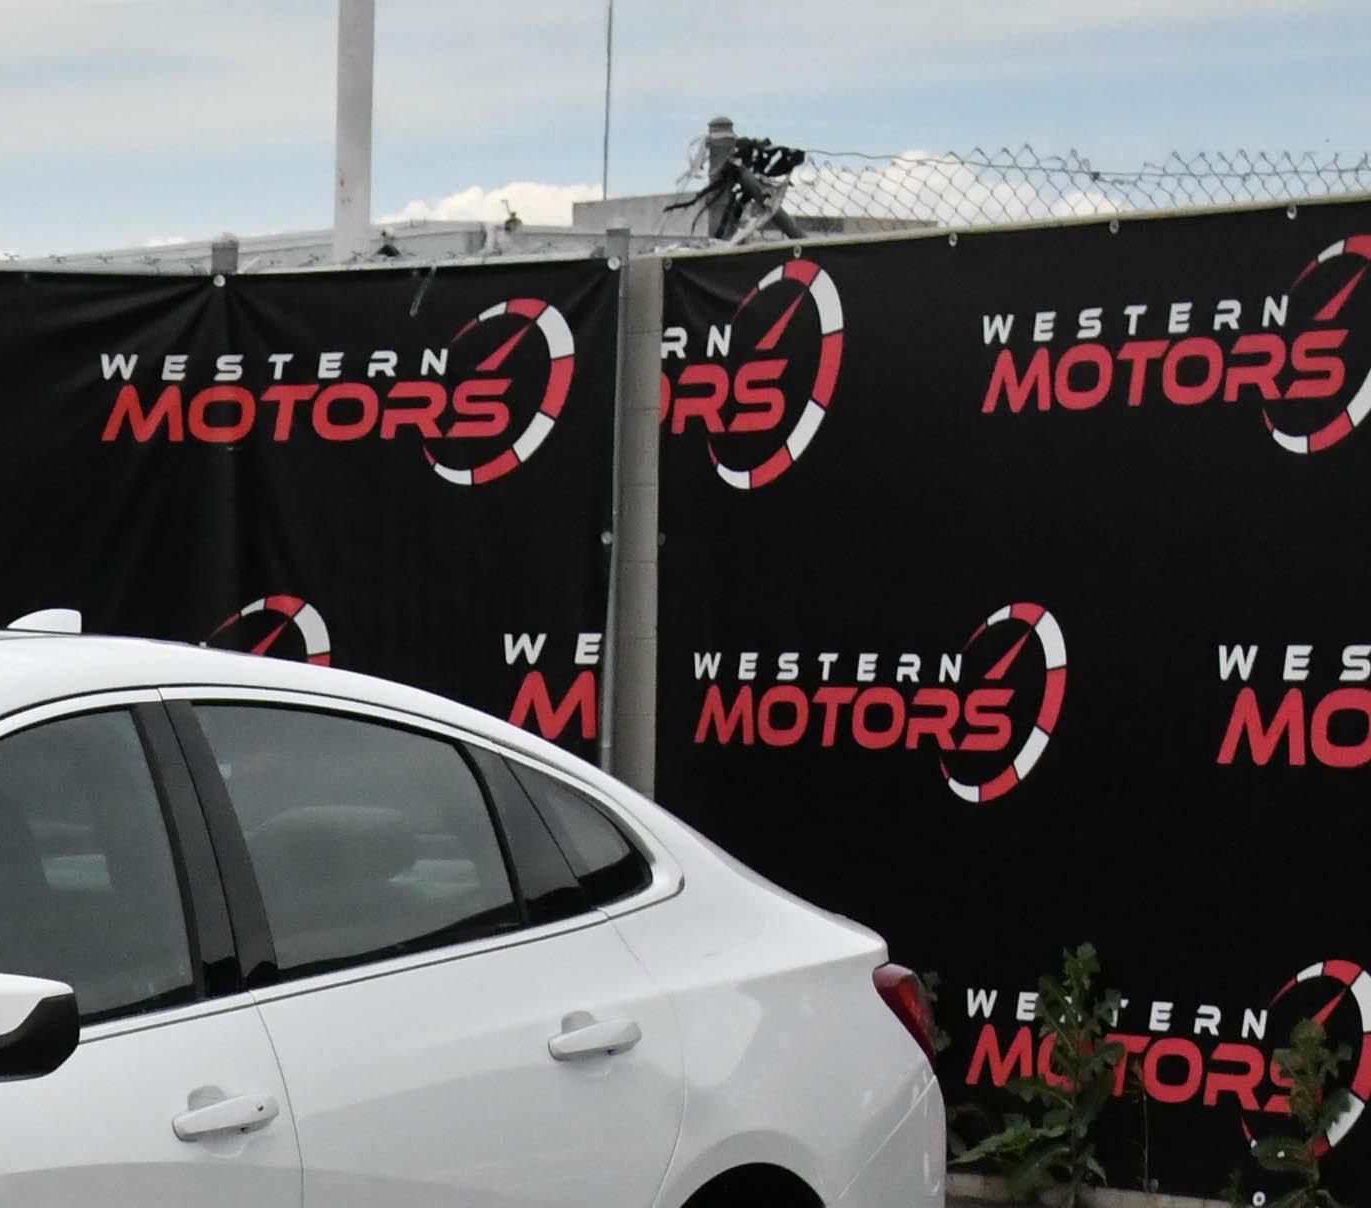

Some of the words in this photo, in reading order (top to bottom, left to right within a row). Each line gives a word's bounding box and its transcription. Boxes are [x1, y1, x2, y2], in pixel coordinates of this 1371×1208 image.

[983, 295, 1289, 345] WESTERN
[100, 348, 449, 381] WESTERN
[982, 329, 1348, 414] MOTORS
[102, 378, 512, 443] MOTORS
[694, 652, 962, 683] WESTERN
[695, 685, 1015, 751] MOTORS
[967, 988, 1268, 1040] WETERN
